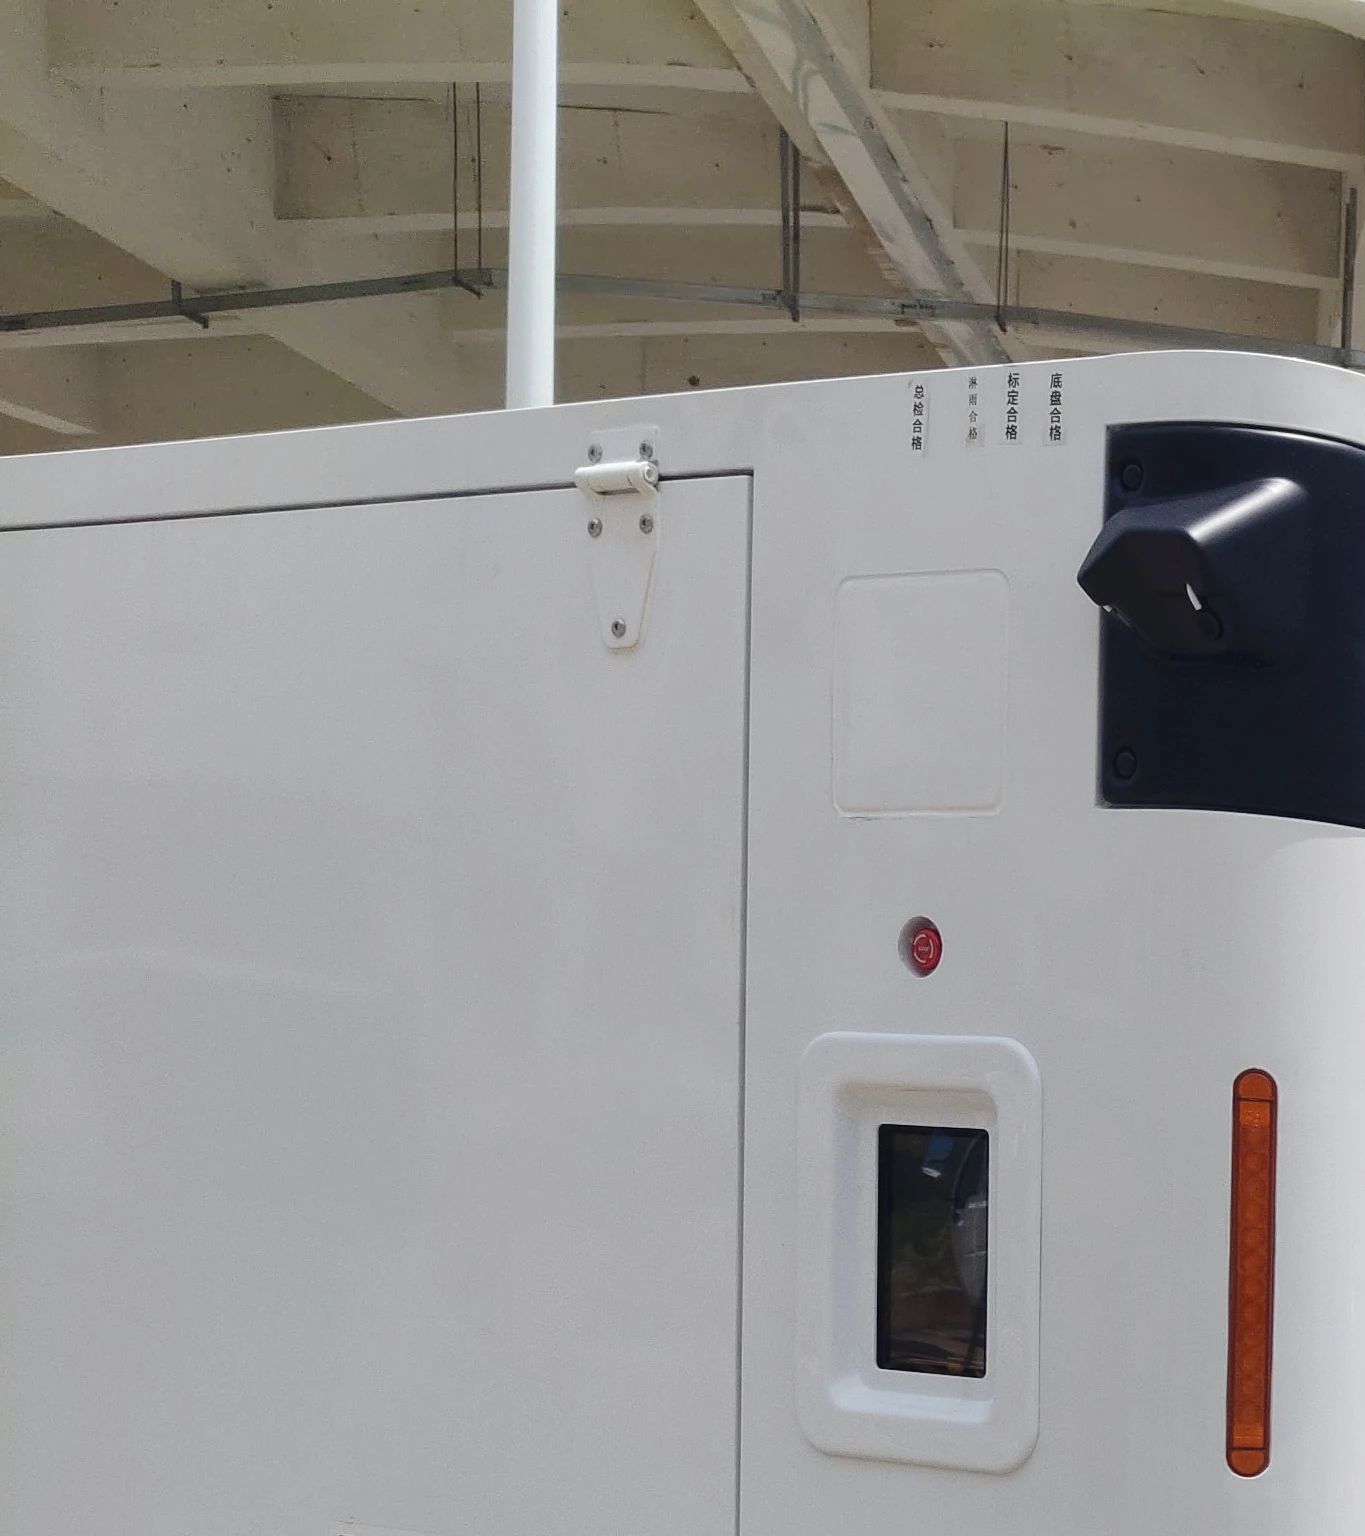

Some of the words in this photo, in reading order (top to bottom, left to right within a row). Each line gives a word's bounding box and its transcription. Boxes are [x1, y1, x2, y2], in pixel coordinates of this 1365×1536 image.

[911, 385, 925, 451] 总检合格
[968, 376, 978, 440] 淋雨合格
[1005, 373, 1020, 440] 标定合格
[1049, 373, 1063, 441] 底盘合格
